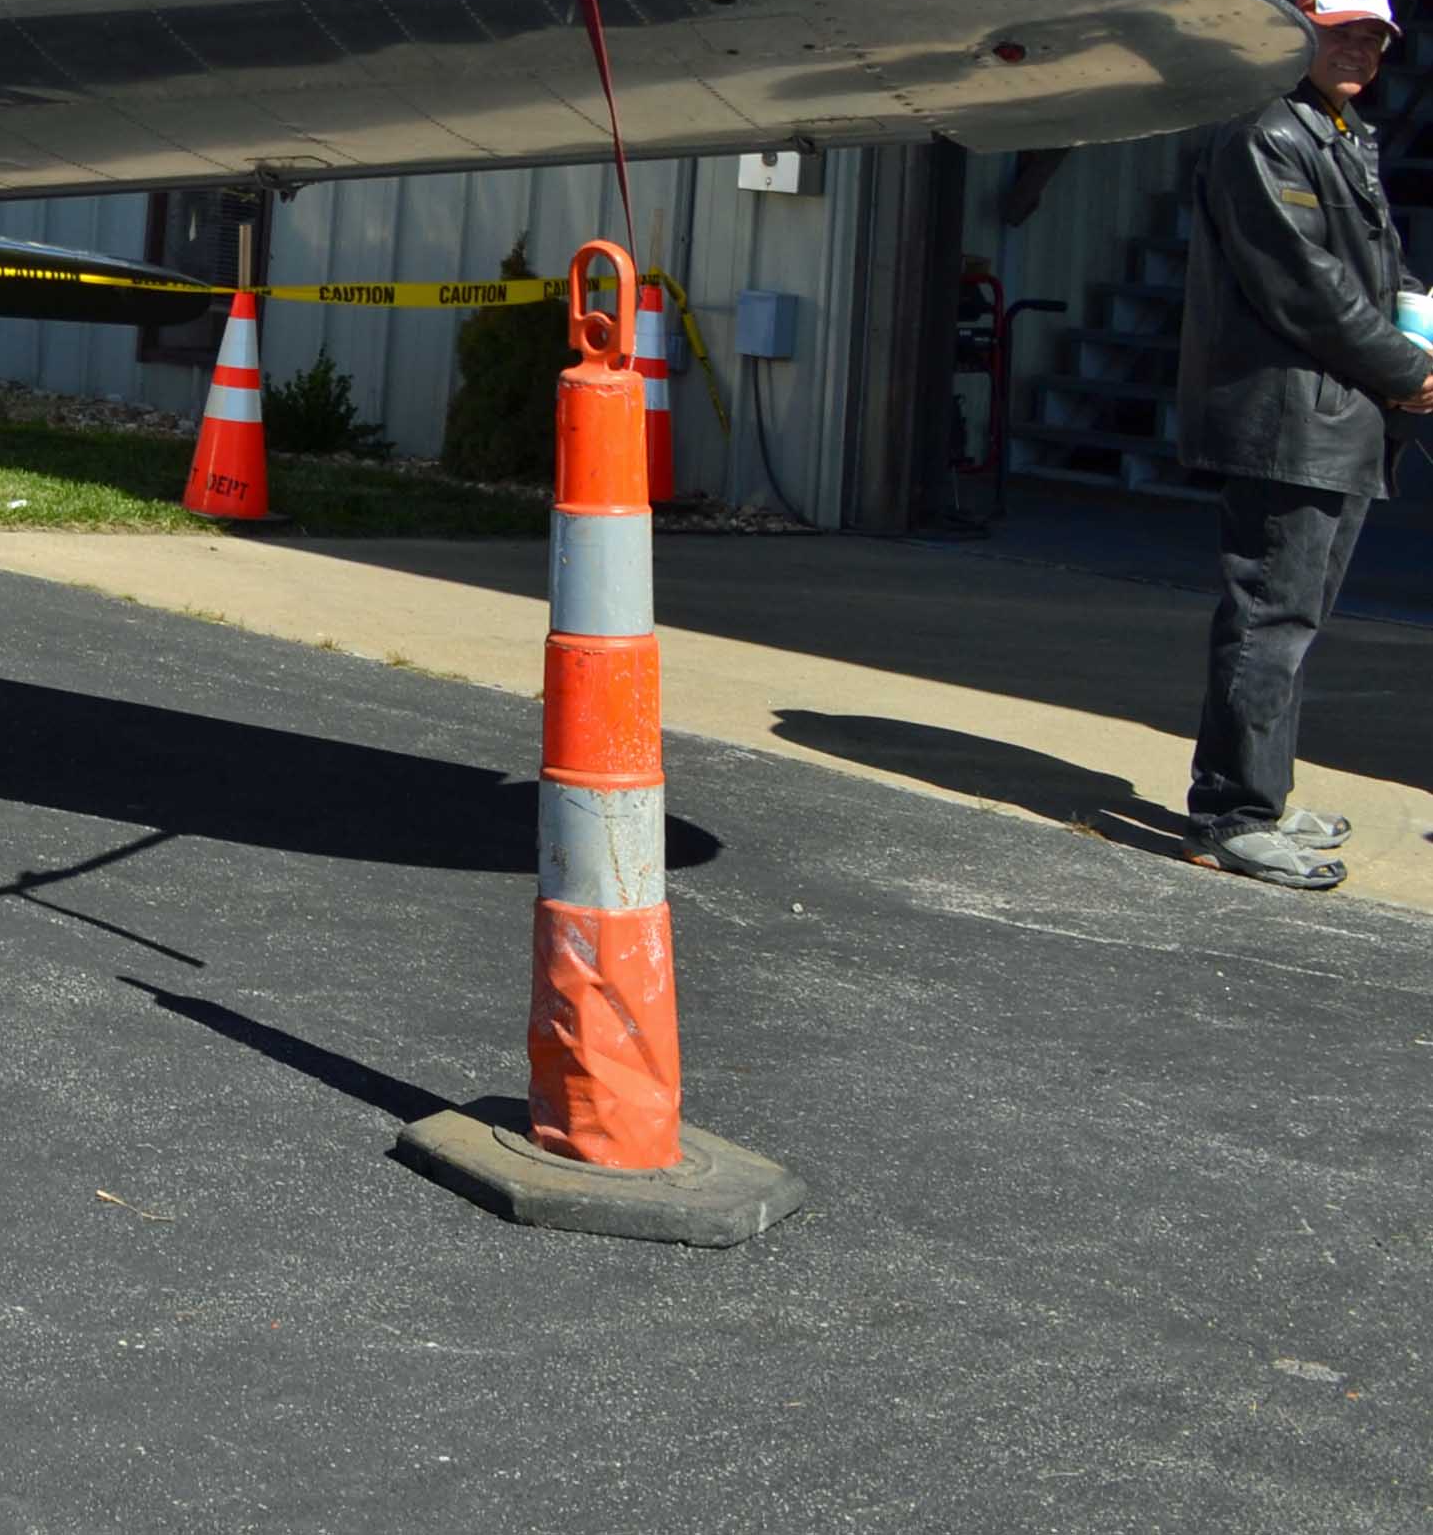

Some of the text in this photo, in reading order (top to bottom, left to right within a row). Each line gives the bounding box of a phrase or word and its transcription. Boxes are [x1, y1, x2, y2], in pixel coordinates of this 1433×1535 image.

[318, 285, 395, 304] CAUTION
[439, 284, 508, 304] CAUTION
[208, 472, 250, 502] DEPT
